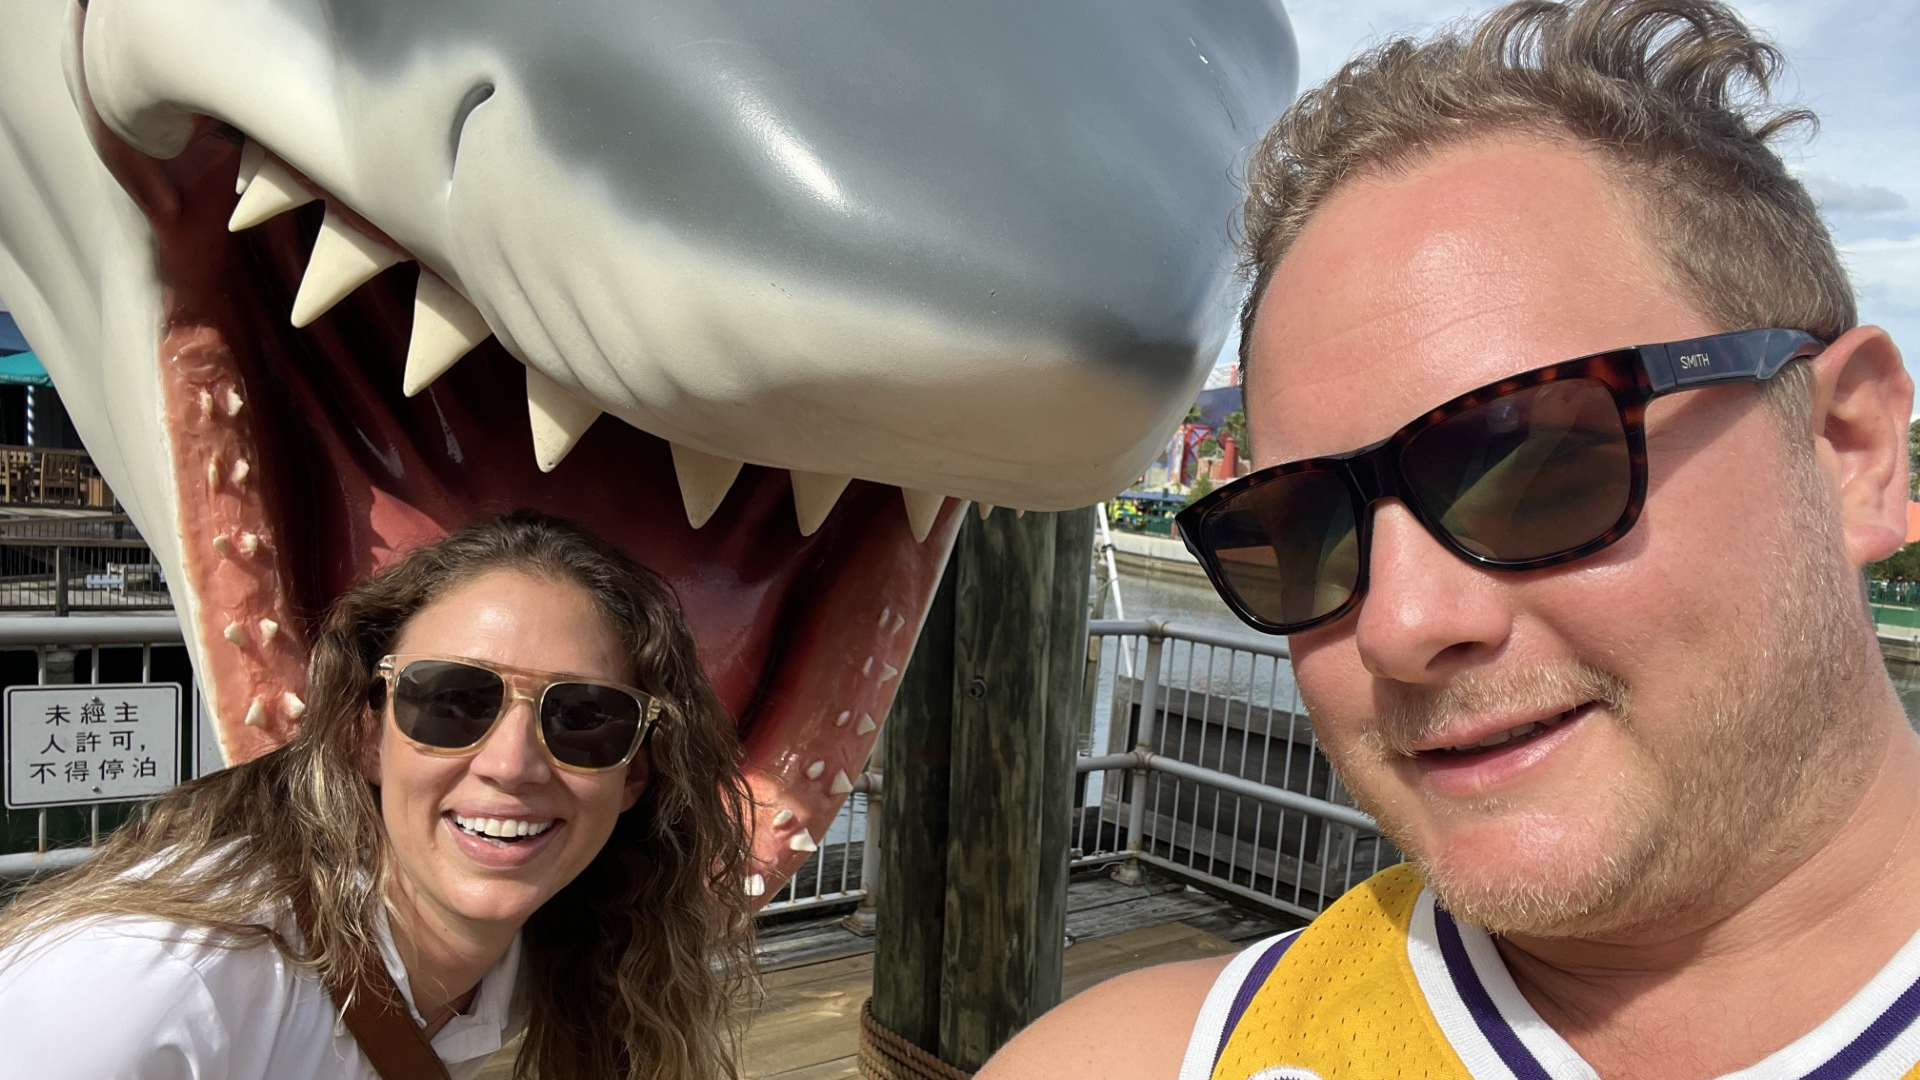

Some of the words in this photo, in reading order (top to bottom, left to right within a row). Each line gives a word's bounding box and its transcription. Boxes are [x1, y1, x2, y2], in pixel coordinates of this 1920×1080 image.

[1680, 353, 1710, 369] SMITH
[45, 702, 139, 726] 未經主
[30, 756, 156, 784] 不得停泊
